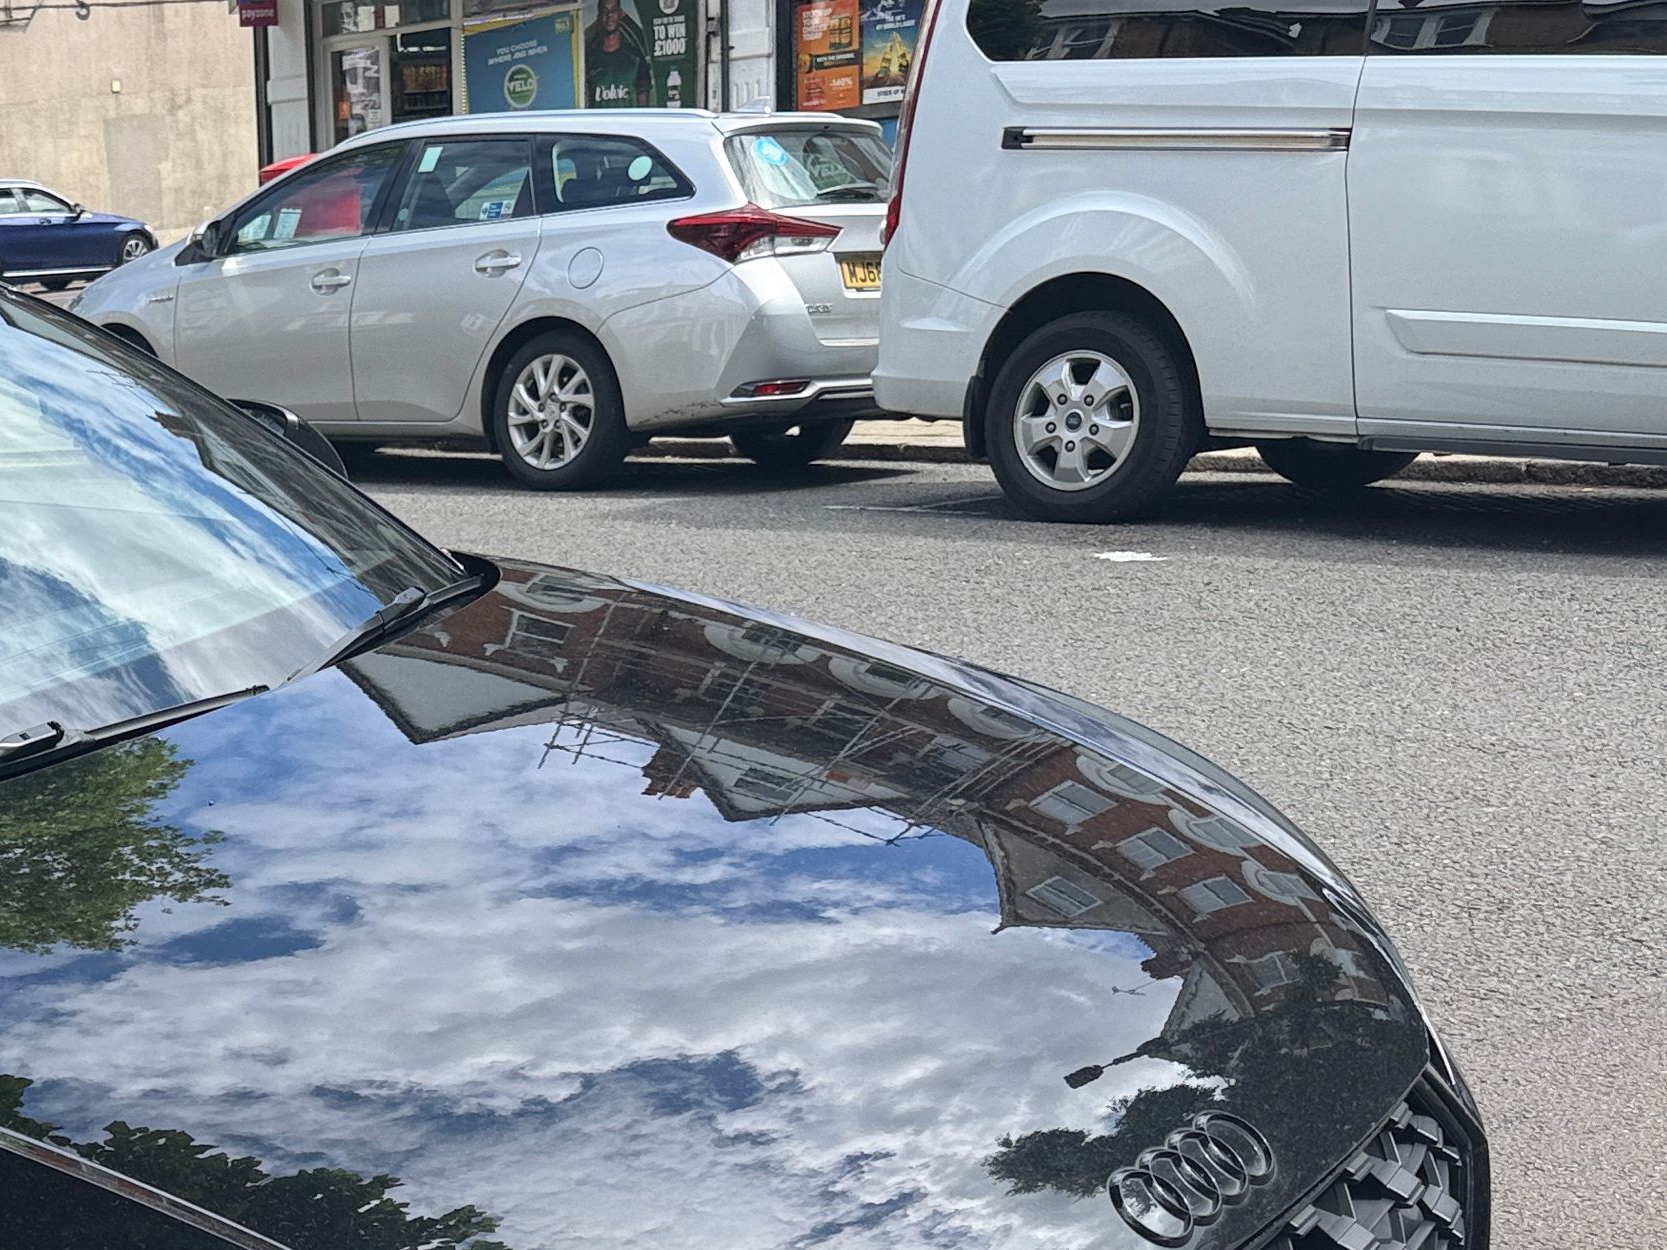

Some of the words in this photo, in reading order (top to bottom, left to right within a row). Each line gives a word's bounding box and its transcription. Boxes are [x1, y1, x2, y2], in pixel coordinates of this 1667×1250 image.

[242, 9, 274, 20] payzone
[653, 26, 666, 40] TO
[667, 22, 686, 38] WIN
[507, 79, 534, 93] VELO
